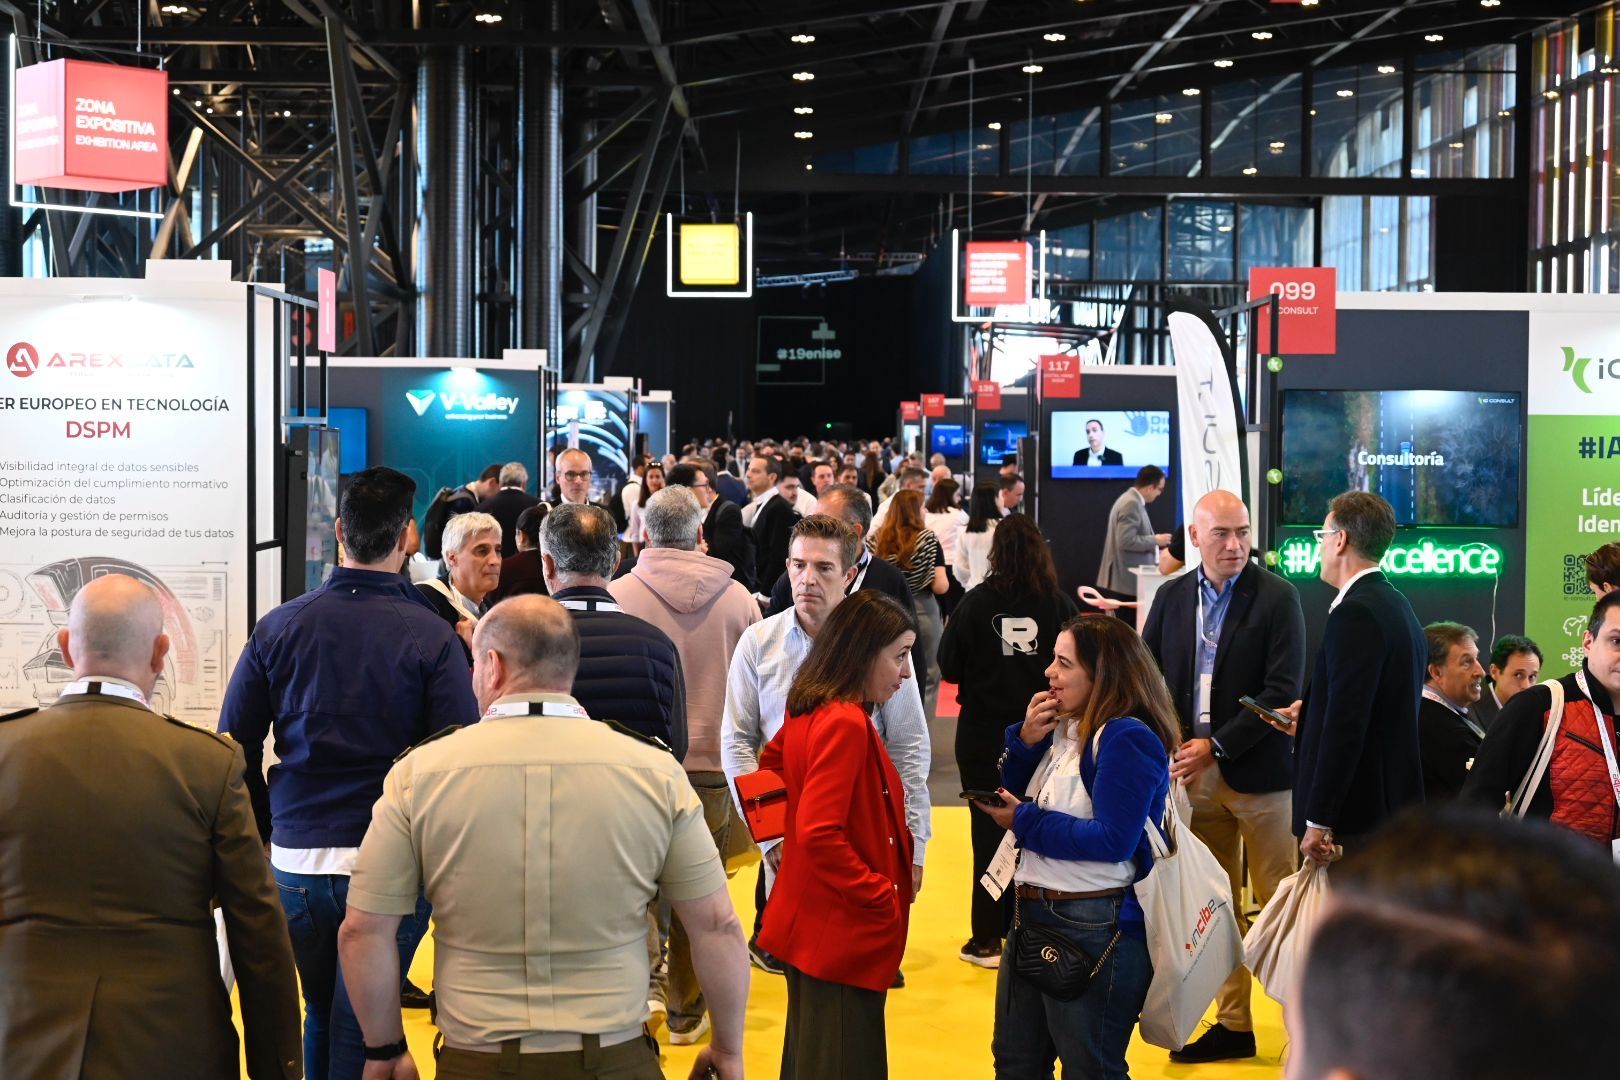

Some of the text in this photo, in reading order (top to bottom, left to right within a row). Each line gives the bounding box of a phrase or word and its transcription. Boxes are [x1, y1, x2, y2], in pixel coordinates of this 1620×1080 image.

[75, 97, 117, 116] ZONA
[75, 114, 156, 136] EXPOSITIVA
[75, 134, 131, 150] EXHIBITION
[131, 140, 159, 153] AREA
[1269, 281, 1316, 301] 099
[46, 352, 195, 369] AREXATA
[1048, 360, 1071, 372] 117
[20, 397, 97, 411] EUROPEO
[101, 398, 122, 411] EN
[127, 395, 230, 412] TECNOLOGÍA
[66, 420, 131, 438] DSPM
[1358, 450, 1445, 466] Consultoría
[0, 461, 200, 473] Visibilidad integral de datos sensibles
[0, 477, 229, 490] Optimización del cumplimiento normativo
[0, 493, 116, 505] Clasificación de datos
[50, 512, 57, 523] y
[59, 510, 100, 523] gestión
[102, 511, 117, 521] de
[119, 512, 169, 523] permisos
[0, 526, 235, 540] Mejora la postura de seguridad de tus datos
